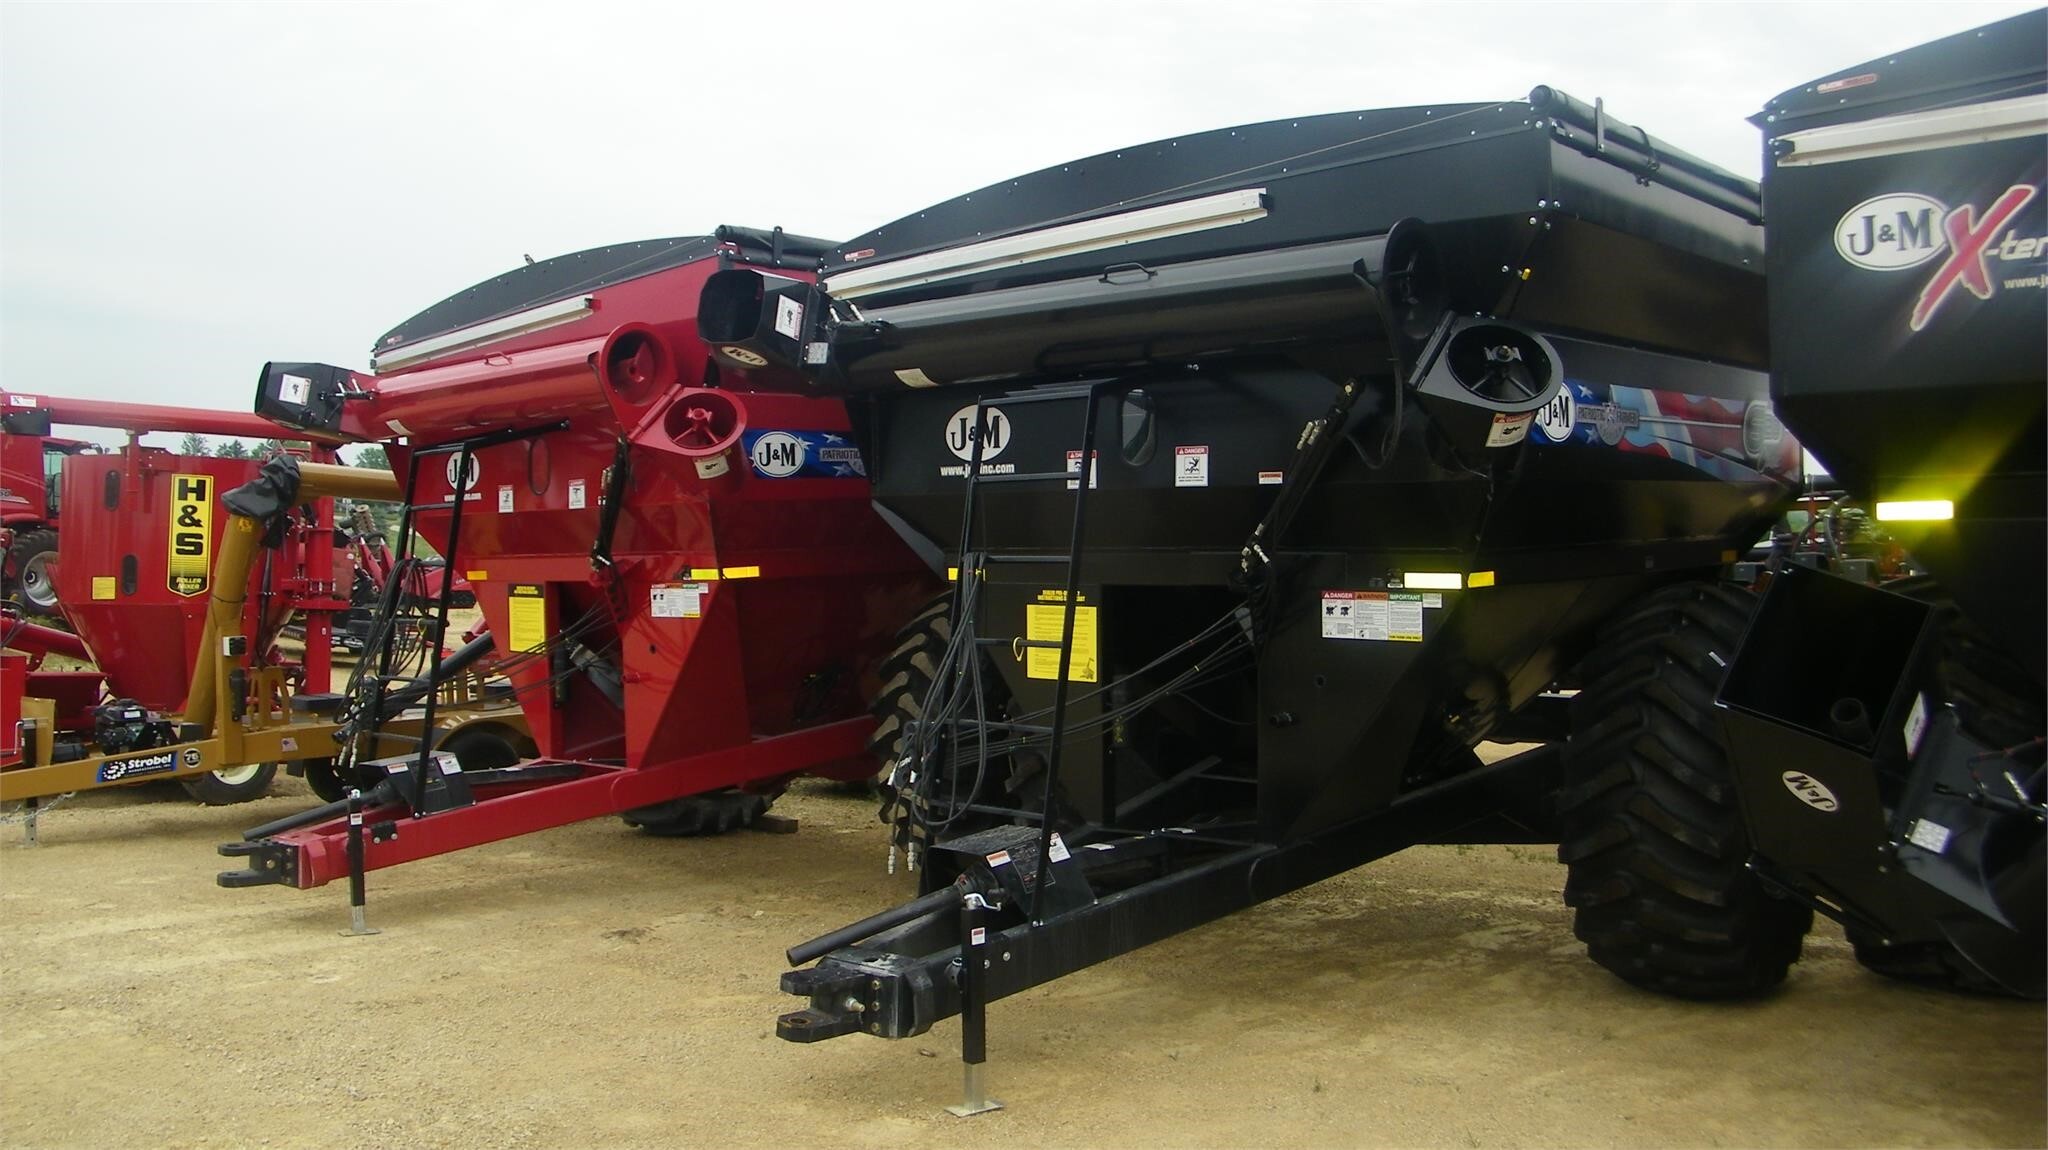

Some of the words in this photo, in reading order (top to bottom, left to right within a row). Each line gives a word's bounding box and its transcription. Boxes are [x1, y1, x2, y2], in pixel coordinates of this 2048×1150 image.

[1847, 208, 1935, 256] J&M
[951, 415, 1000, 451] J&M
[759, 443, 796, 467] J&M
[127, 754, 172, 769] Strobel
[1786, 775, 1836, 809] J&M
